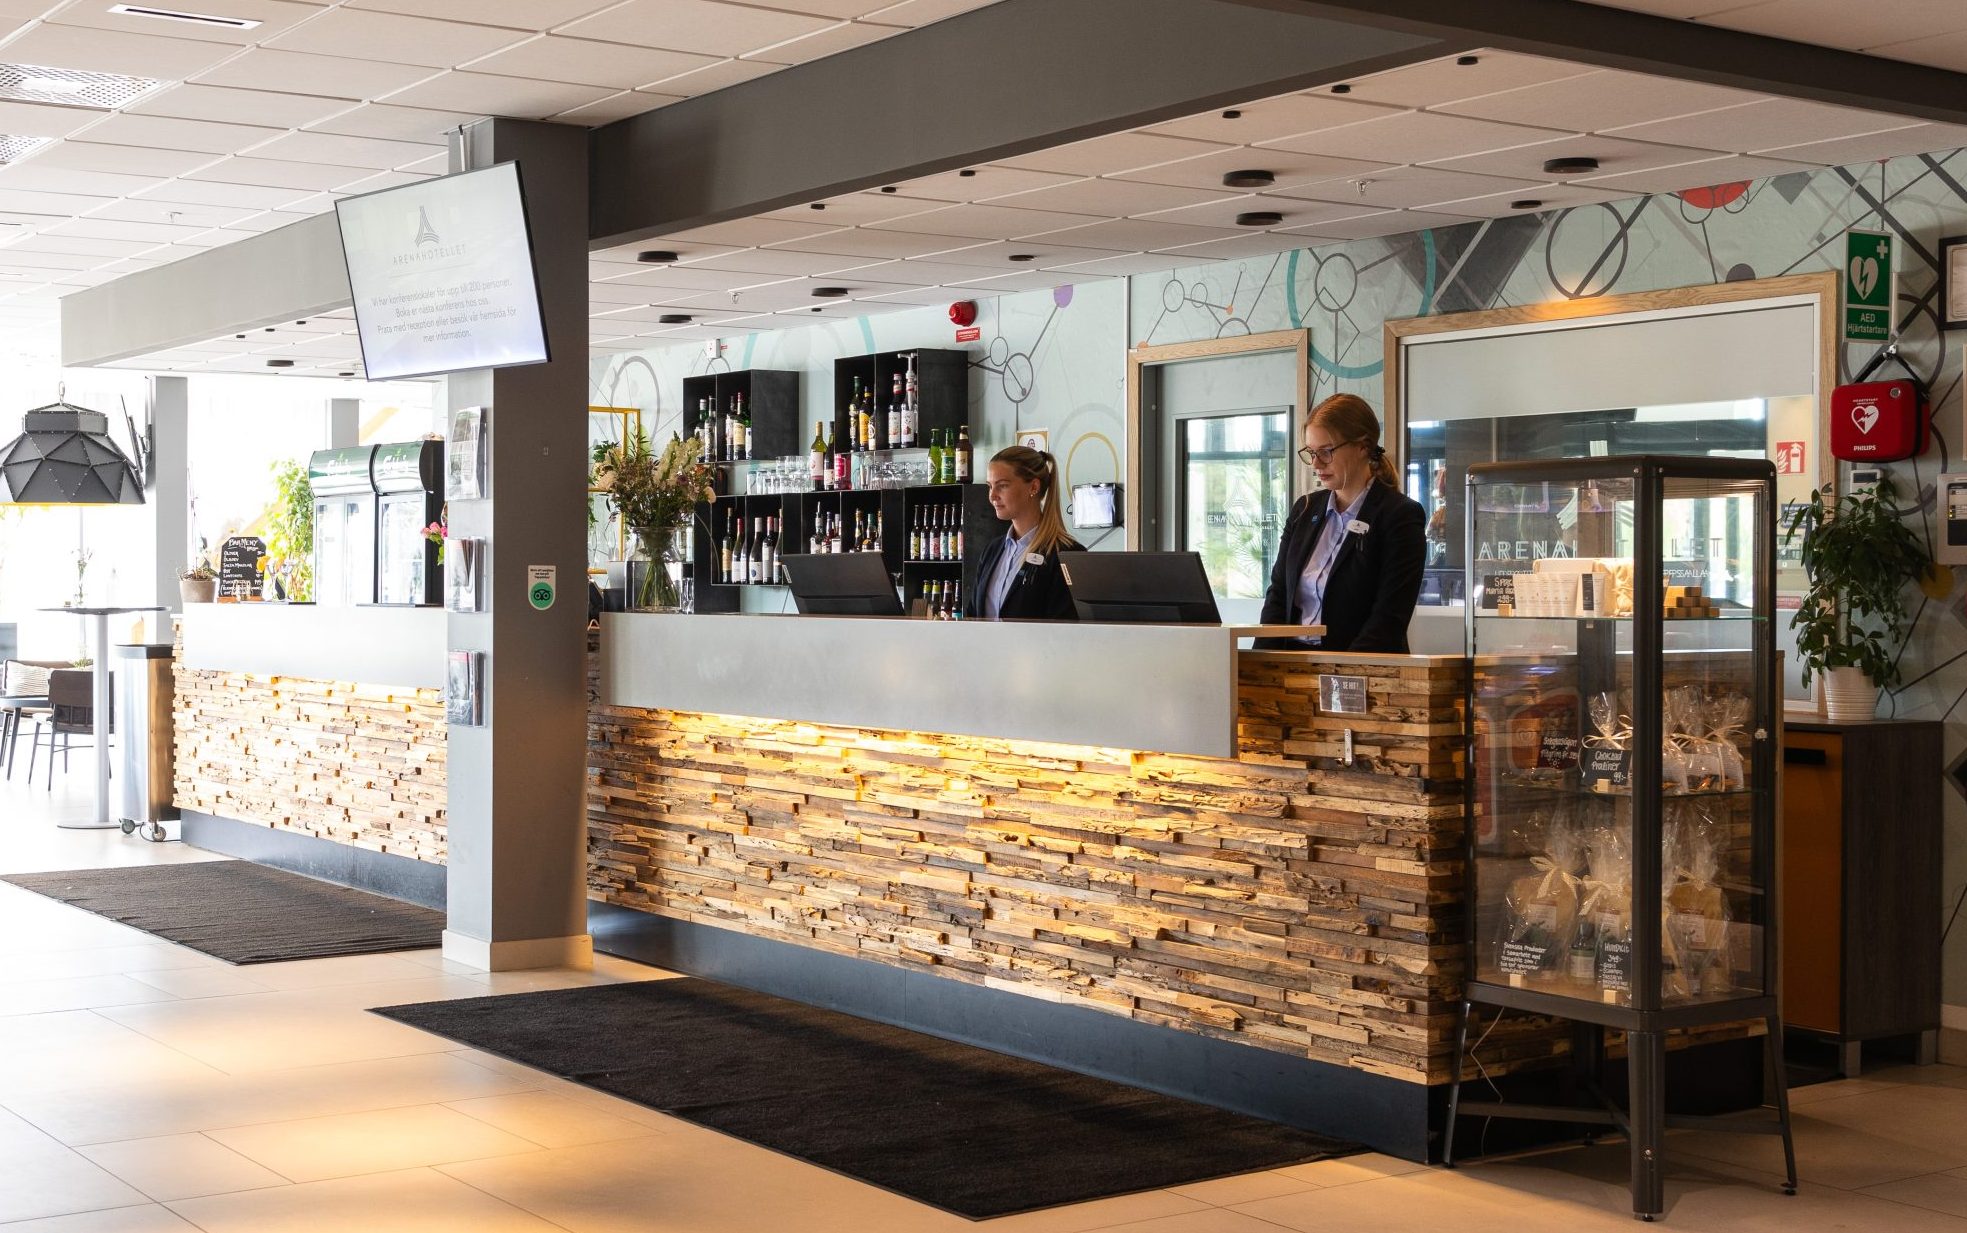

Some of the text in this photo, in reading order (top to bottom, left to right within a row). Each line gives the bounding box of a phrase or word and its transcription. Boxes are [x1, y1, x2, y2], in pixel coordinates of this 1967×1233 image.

[392, 244, 466, 265] ARENAHOTELLET
[469, 281, 480, 292] 200
[396, 308, 410, 318] Boka
[1860, 312, 1876, 322] AED
[377, 324, 392, 334] Prata
[393, 323, 406, 332] med
[1342, 682, 1348, 690] SE
[1614, 772, 1626, 783] 99:-
